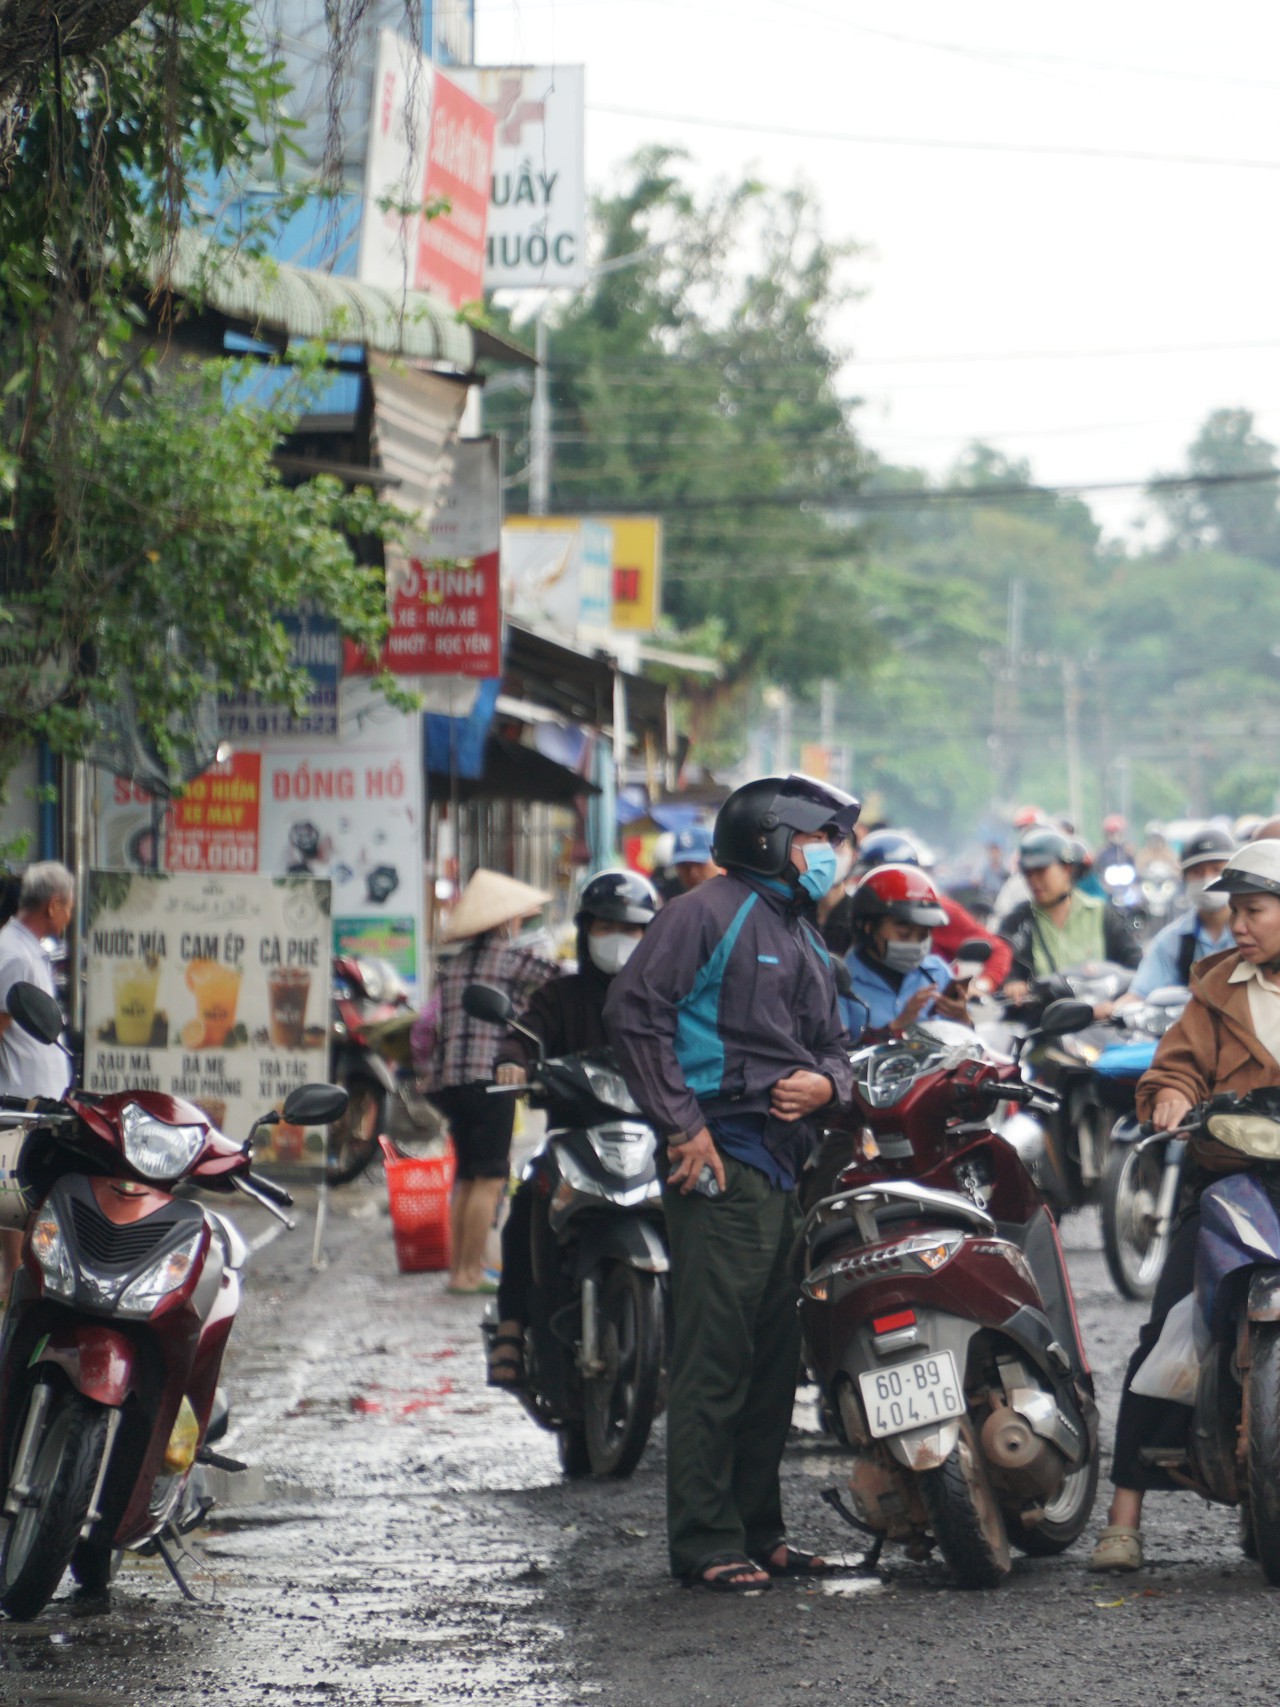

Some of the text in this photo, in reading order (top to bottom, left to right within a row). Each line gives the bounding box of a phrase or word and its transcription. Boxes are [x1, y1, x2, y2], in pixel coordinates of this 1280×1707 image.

[169, 843, 255, 870] 20.000
[181, 932, 219, 961] CAM
[259, 934, 281, 966] CÀ
[875, 1359, 941, 1401] 60-B9
[875, 1386, 958, 1431] 404.16
